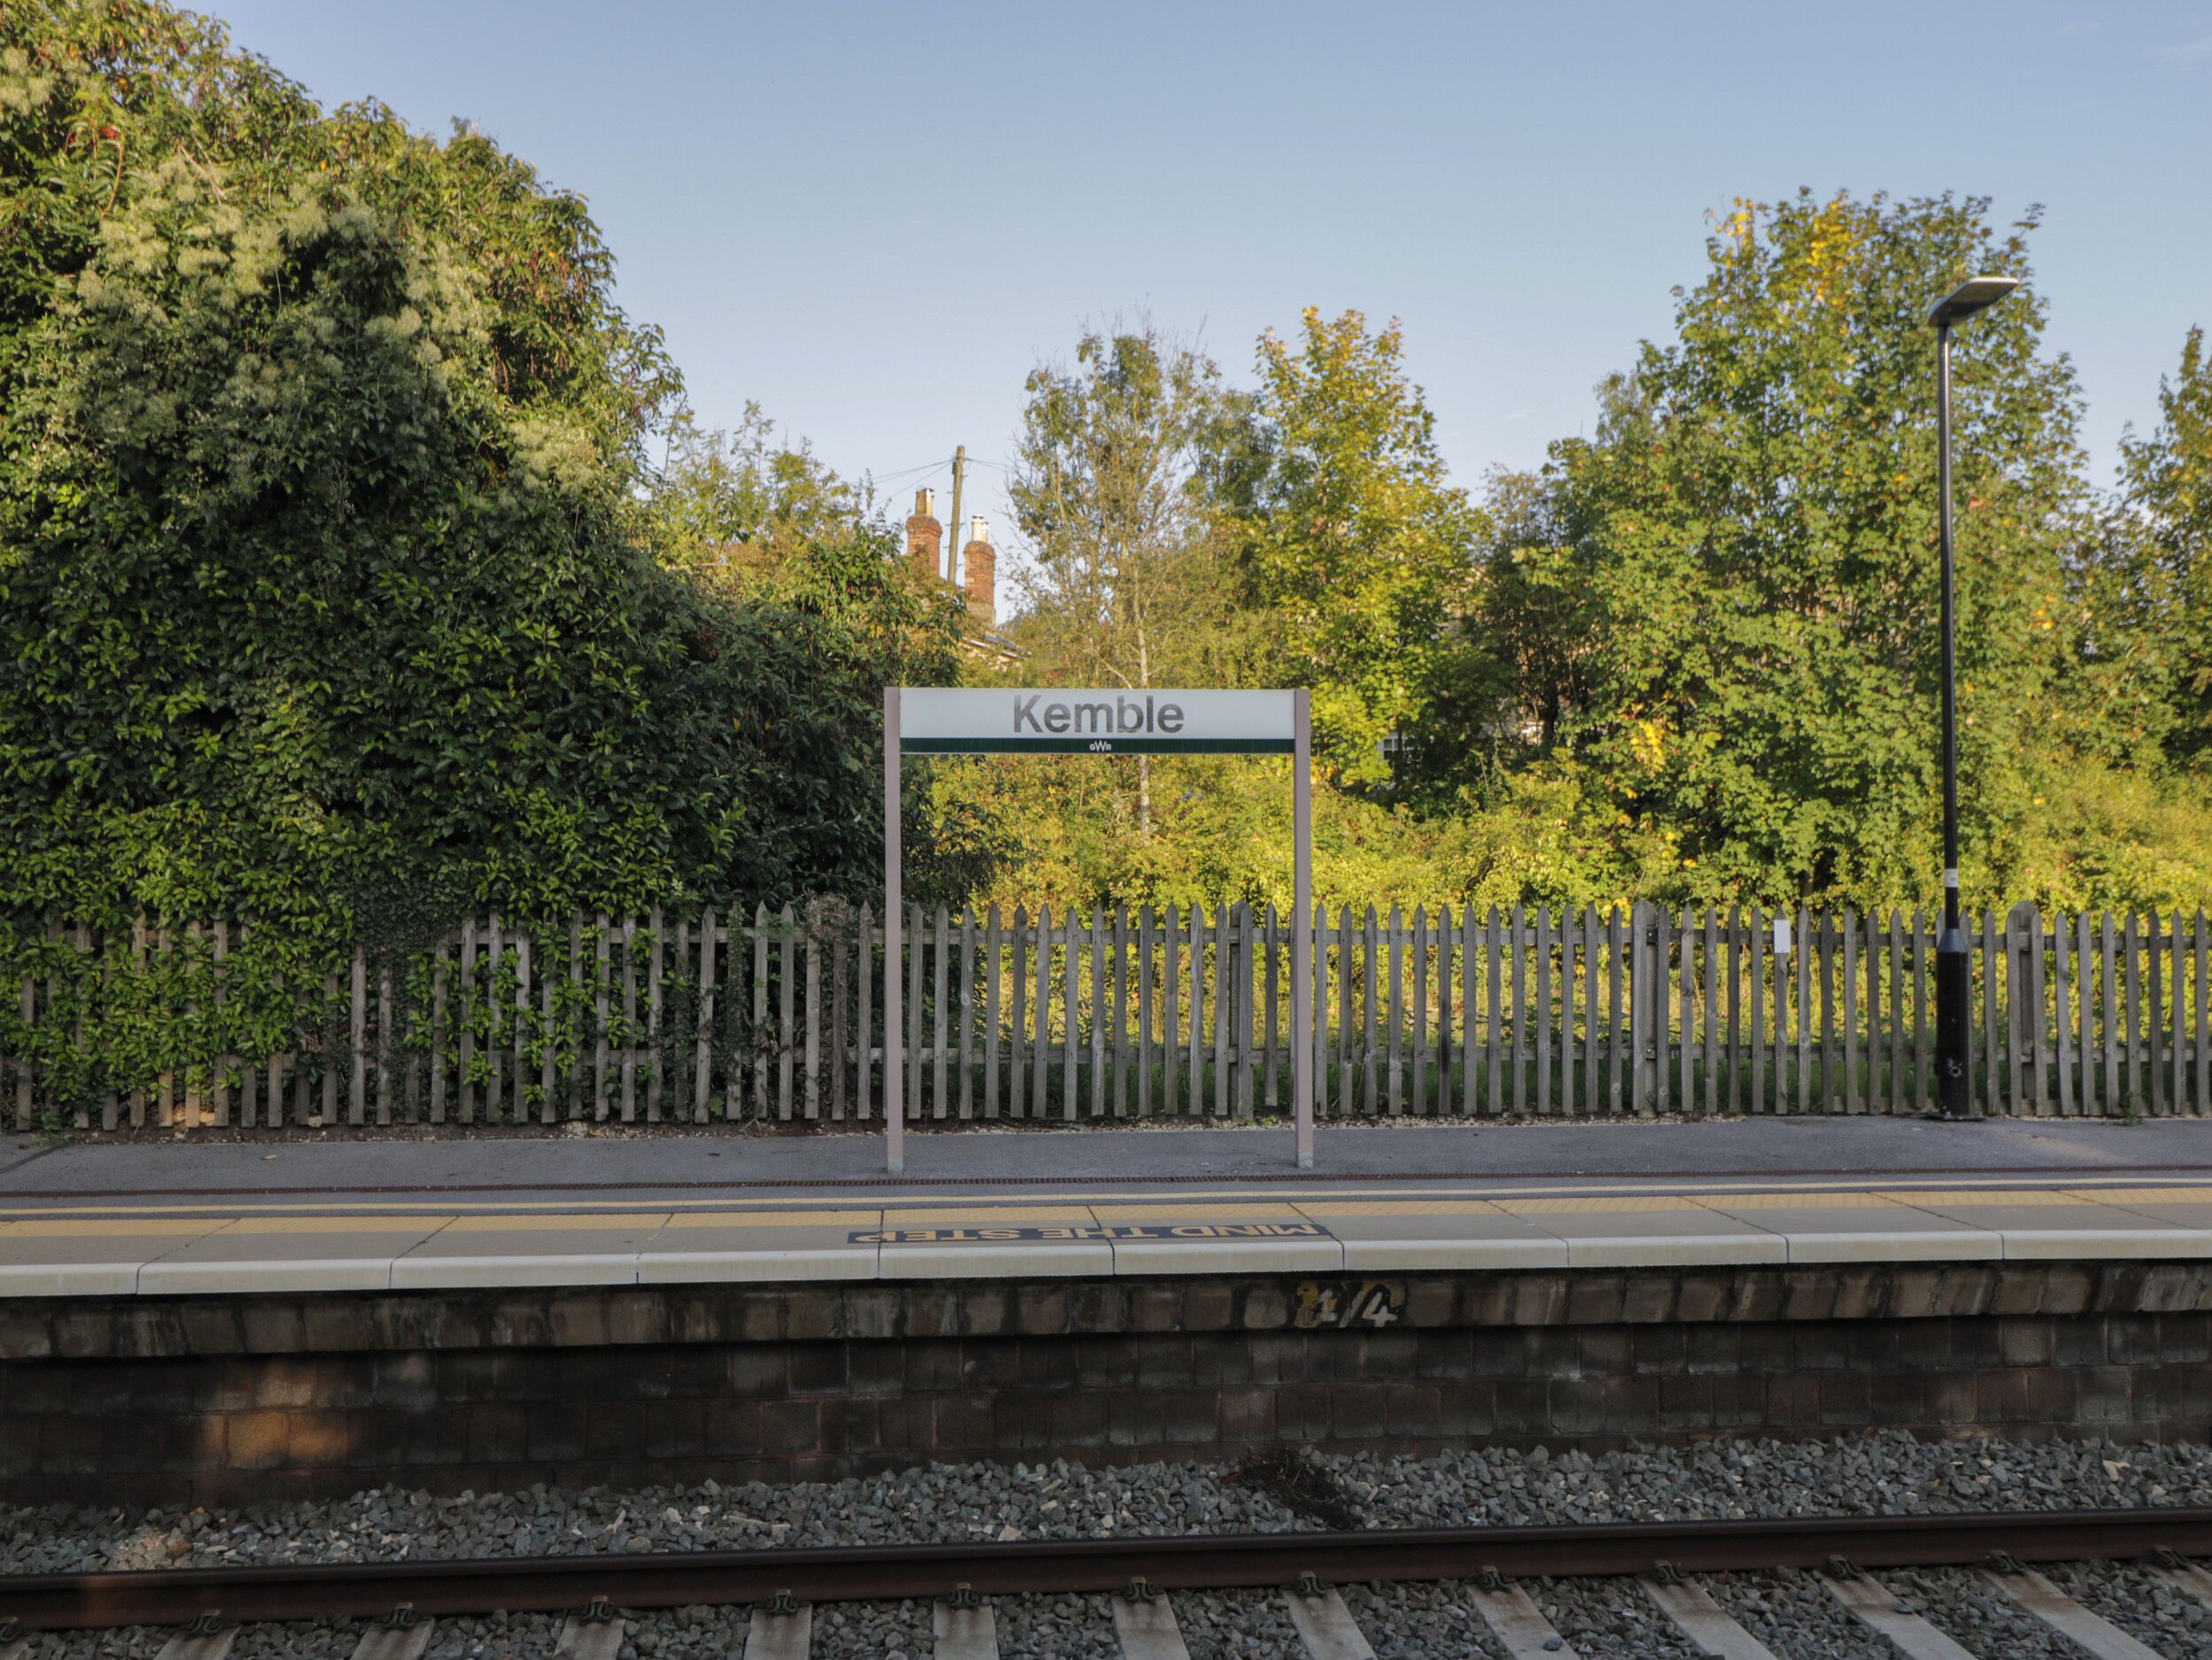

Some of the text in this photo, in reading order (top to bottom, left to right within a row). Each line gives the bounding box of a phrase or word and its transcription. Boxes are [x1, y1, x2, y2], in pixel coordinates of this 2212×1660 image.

[1014, 695, 1184, 733] Kemble
[1089, 739, 1112, 752] GWR
[855, 1225, 1319, 1241] MIND THE STEP
